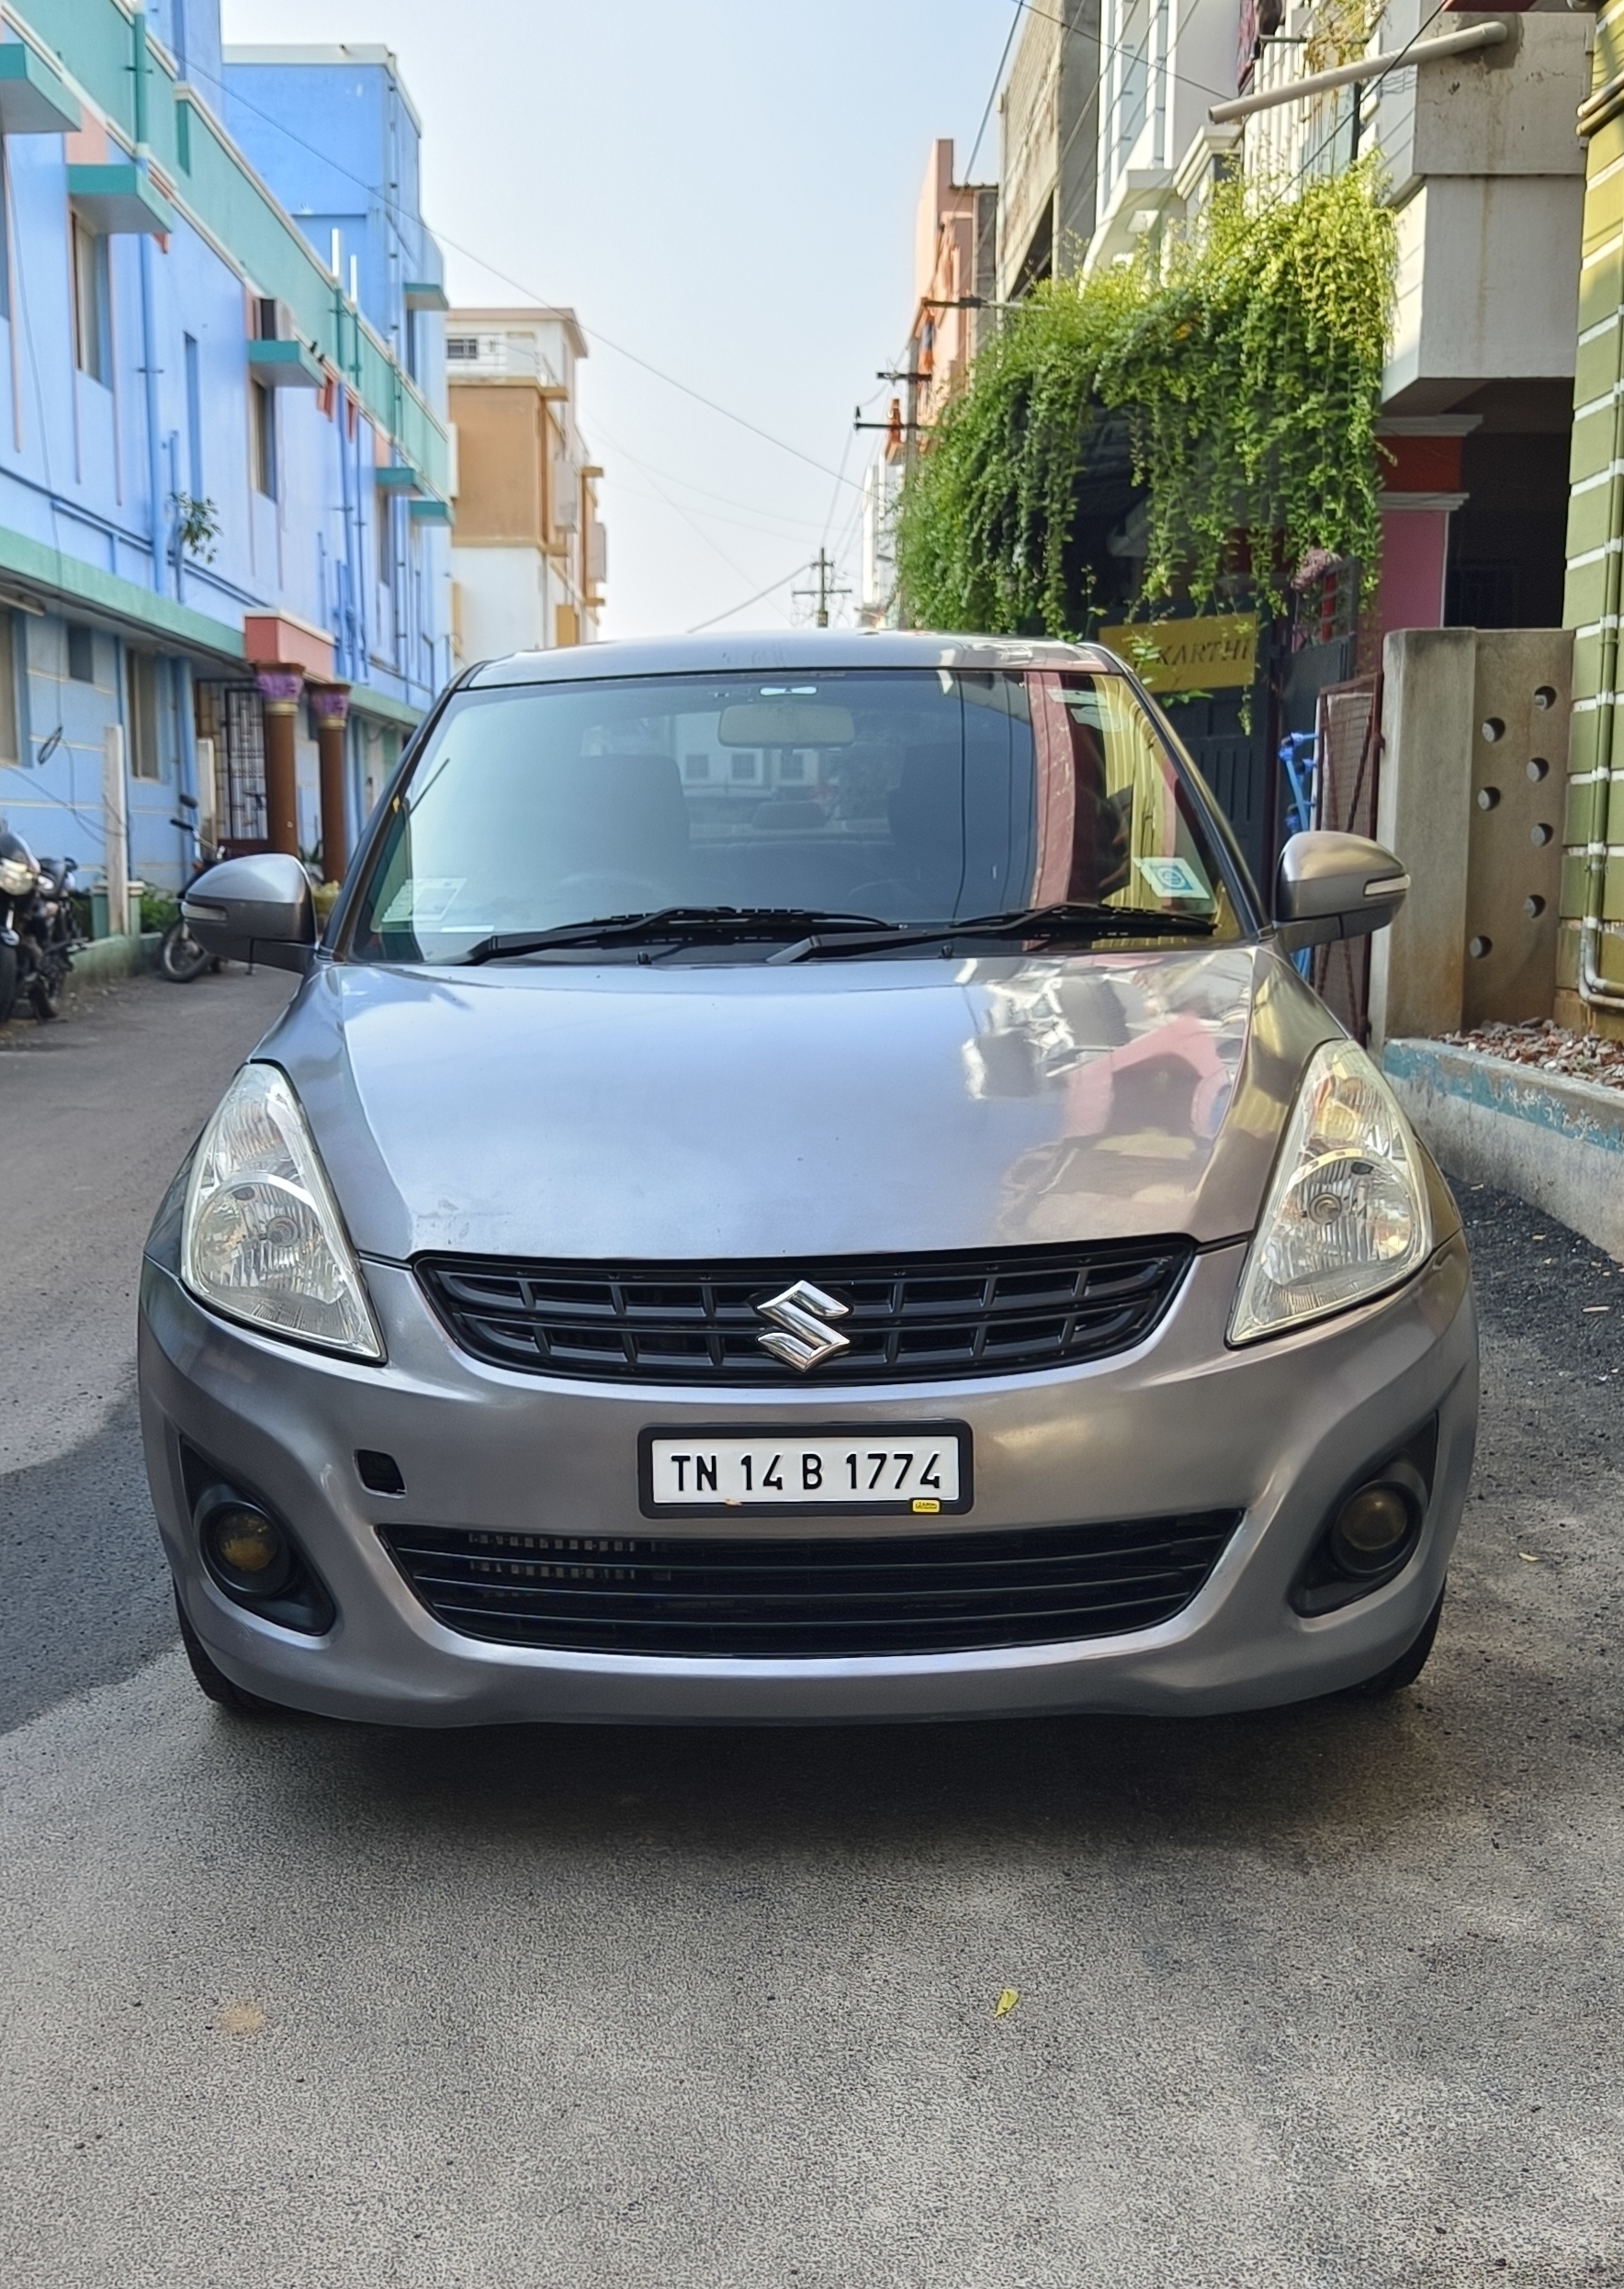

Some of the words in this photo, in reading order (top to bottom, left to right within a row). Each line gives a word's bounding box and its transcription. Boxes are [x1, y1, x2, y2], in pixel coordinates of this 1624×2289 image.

[671, 1455, 718, 1492] TN
[740, 1454, 784, 1491] 14
[802, 1453, 823, 1490] B
[845, 1452, 942, 1489] 1774
